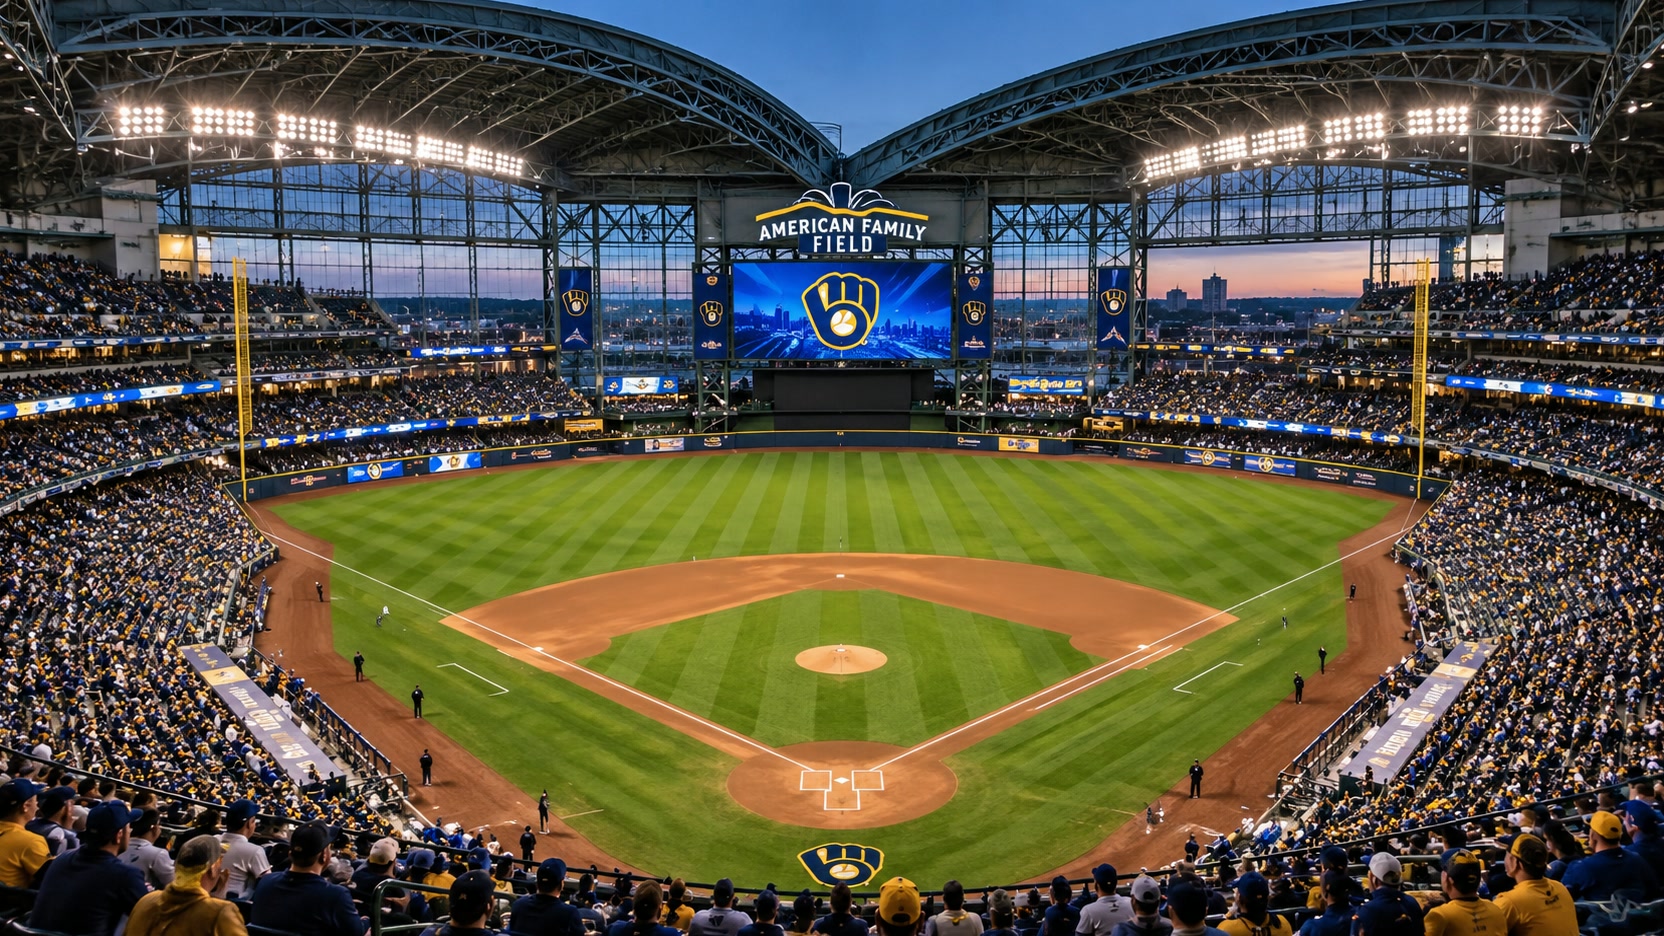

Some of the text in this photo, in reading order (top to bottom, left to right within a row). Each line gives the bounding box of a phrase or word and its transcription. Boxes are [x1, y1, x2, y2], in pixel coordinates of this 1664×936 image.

[759, 217, 927, 241] AMERICAN FAMILY
[813, 235, 872, 252] FIELD
